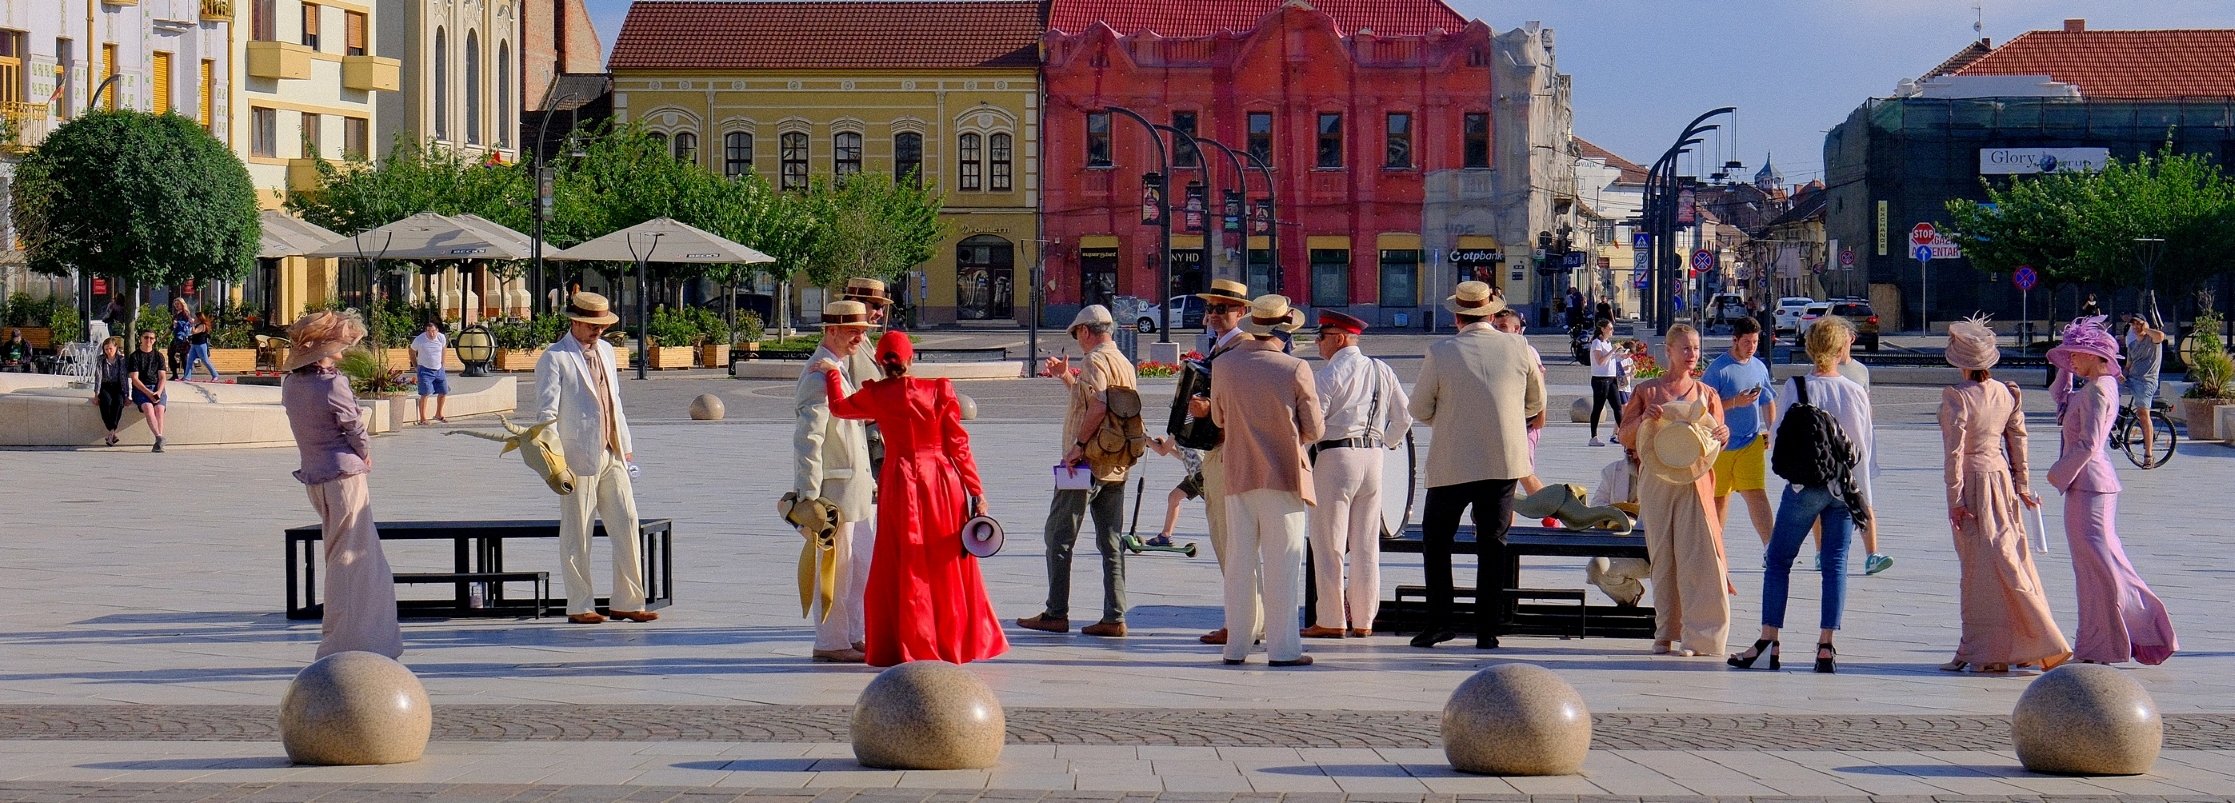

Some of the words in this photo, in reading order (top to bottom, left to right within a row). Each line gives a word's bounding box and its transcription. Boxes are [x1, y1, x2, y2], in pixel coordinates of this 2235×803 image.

[1991, 150, 2035, 168] Glory
[1914, 229, 1934, 239] STOP
[1185, 252, 1199, 262] HD
[1463, 250, 1503, 262] otpbank
[1912, 246, 1959, 257] AENTAR
